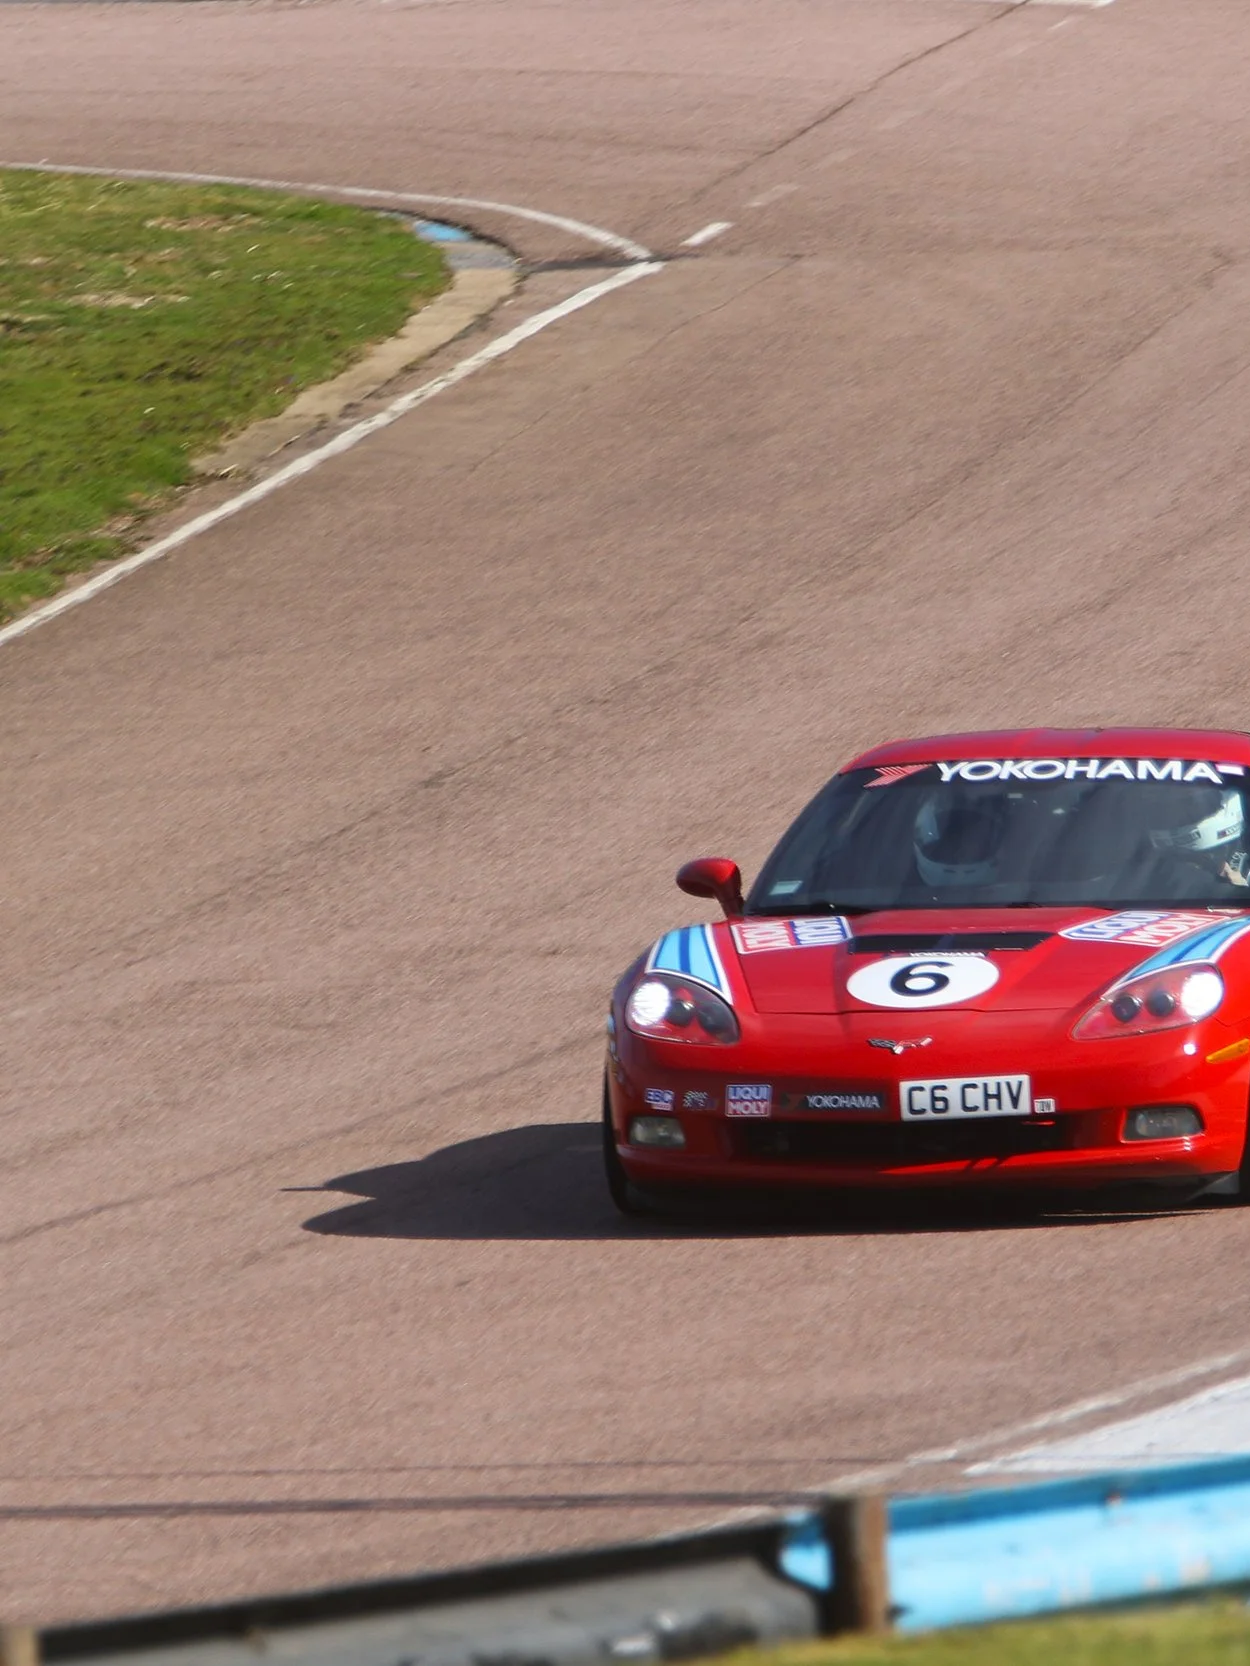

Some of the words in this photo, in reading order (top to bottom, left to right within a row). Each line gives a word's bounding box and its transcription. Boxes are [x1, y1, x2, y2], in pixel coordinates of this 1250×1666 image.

[936, 759, 1223, 784] YOKOHAMA
[1066, 911, 1172, 939] LIQUI
[1117, 914, 1220, 944] MOLY
[890, 960, 955, 997] 6
[728, 1086, 769, 1100] LIQUI
[806, 1095, 880, 1109] YOKOHAMA
[908, 1084, 949, 1115] C6
[961, 1080, 1022, 1112] CHV
[728, 1101, 768, 1115] MOLY
